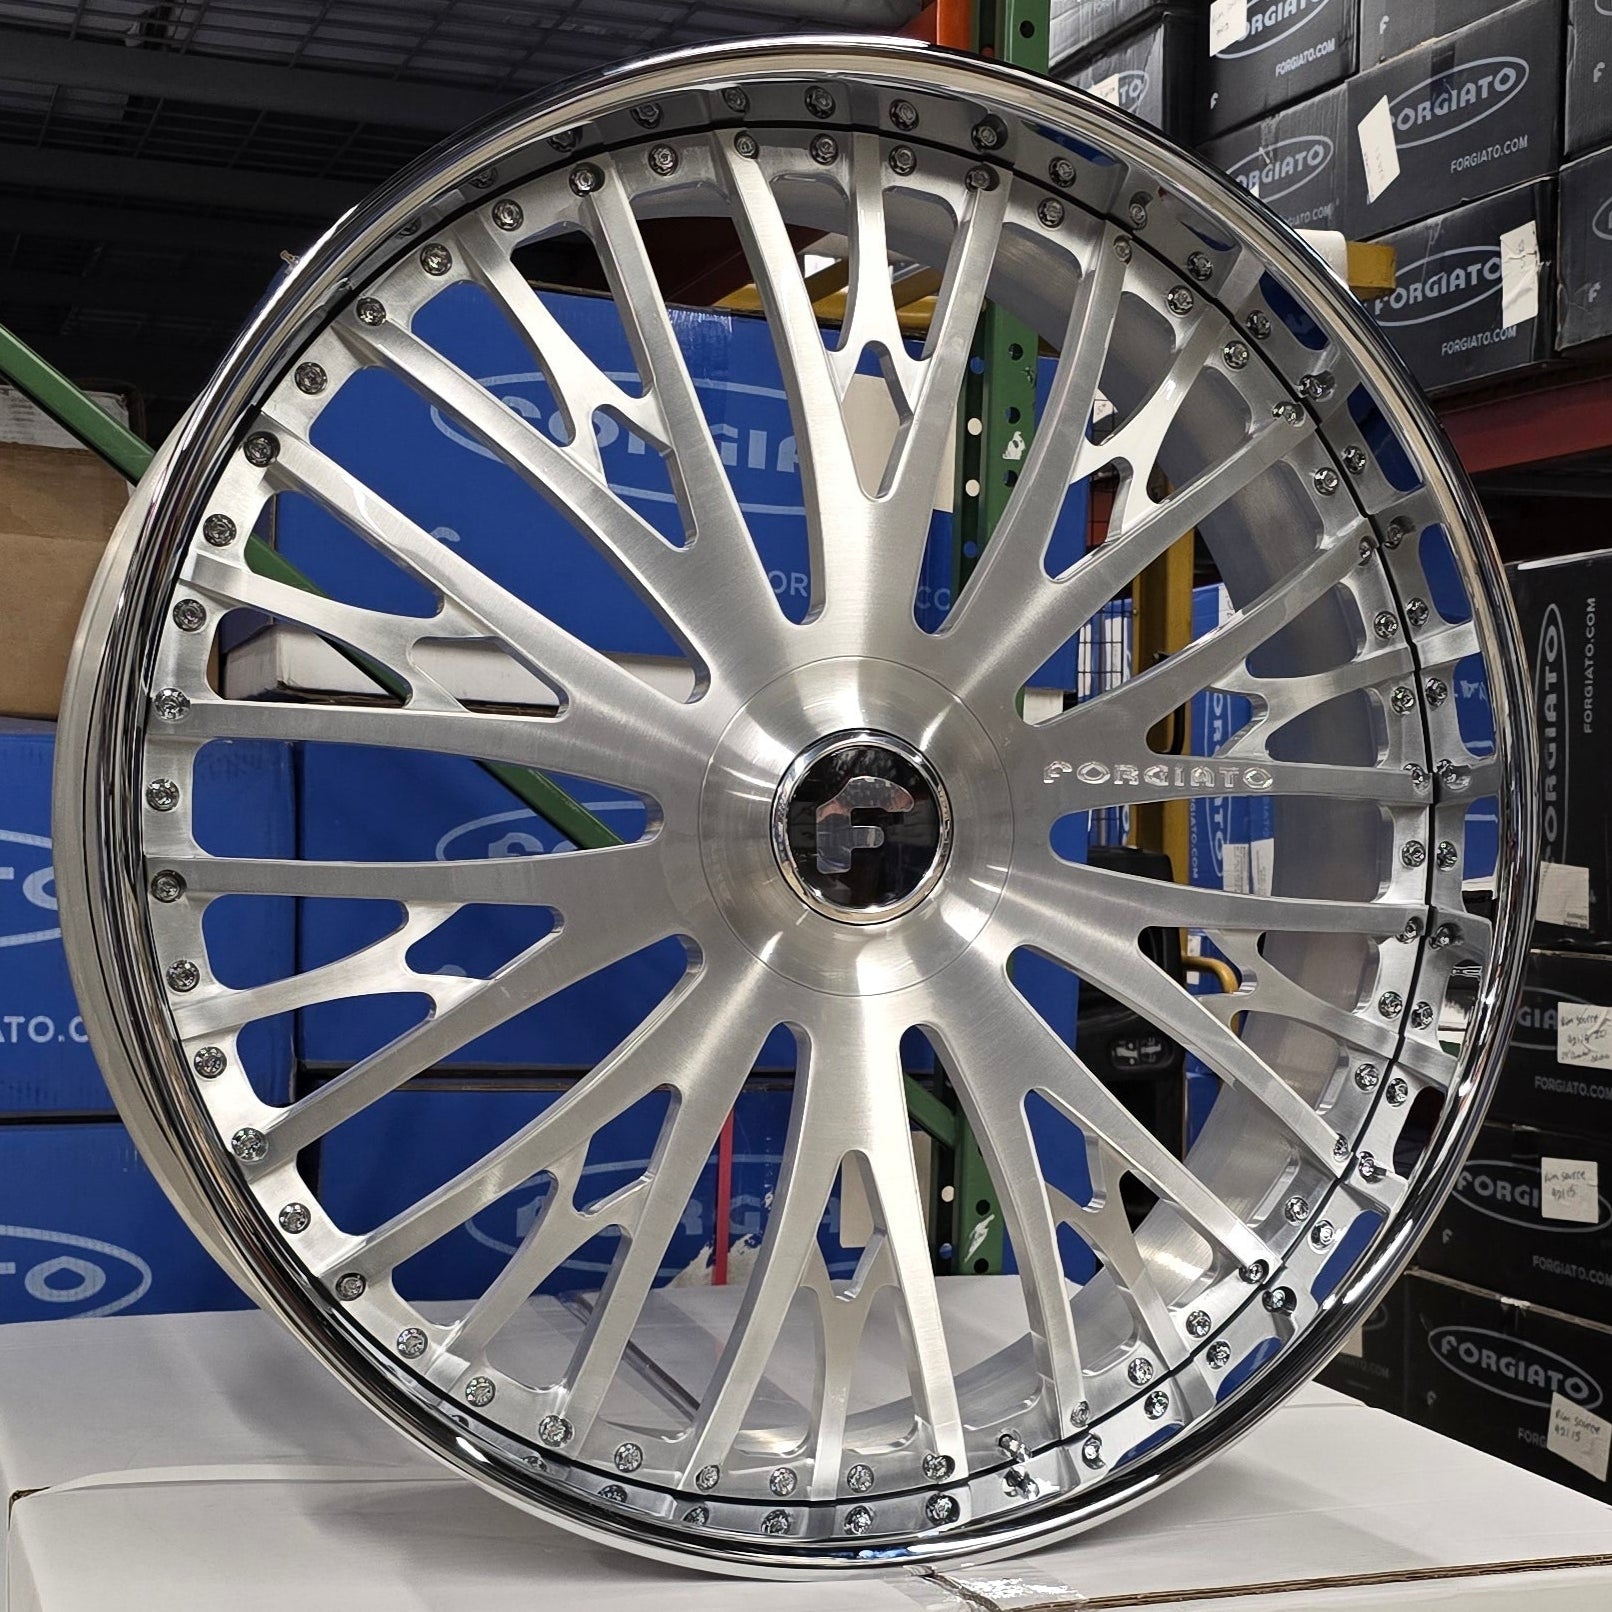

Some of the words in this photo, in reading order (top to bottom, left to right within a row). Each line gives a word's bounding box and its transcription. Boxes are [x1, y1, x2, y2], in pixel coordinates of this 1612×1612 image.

[1275, 38, 1335, 77] FORGIATO.COM
[1391, 67, 1517, 132] ORGIATO
[1451, 134, 1528, 173] FORGIATO.COM
[1441, 325, 1517, 356] FORGIATO.COM
[1584, 598, 1596, 733] FORGIATO.COM
[1043, 761, 1274, 791] FORGIATO
[1457, 1171, 1540, 1208] FORGI
[1441, 1335, 1589, 1399] FORGIATO
